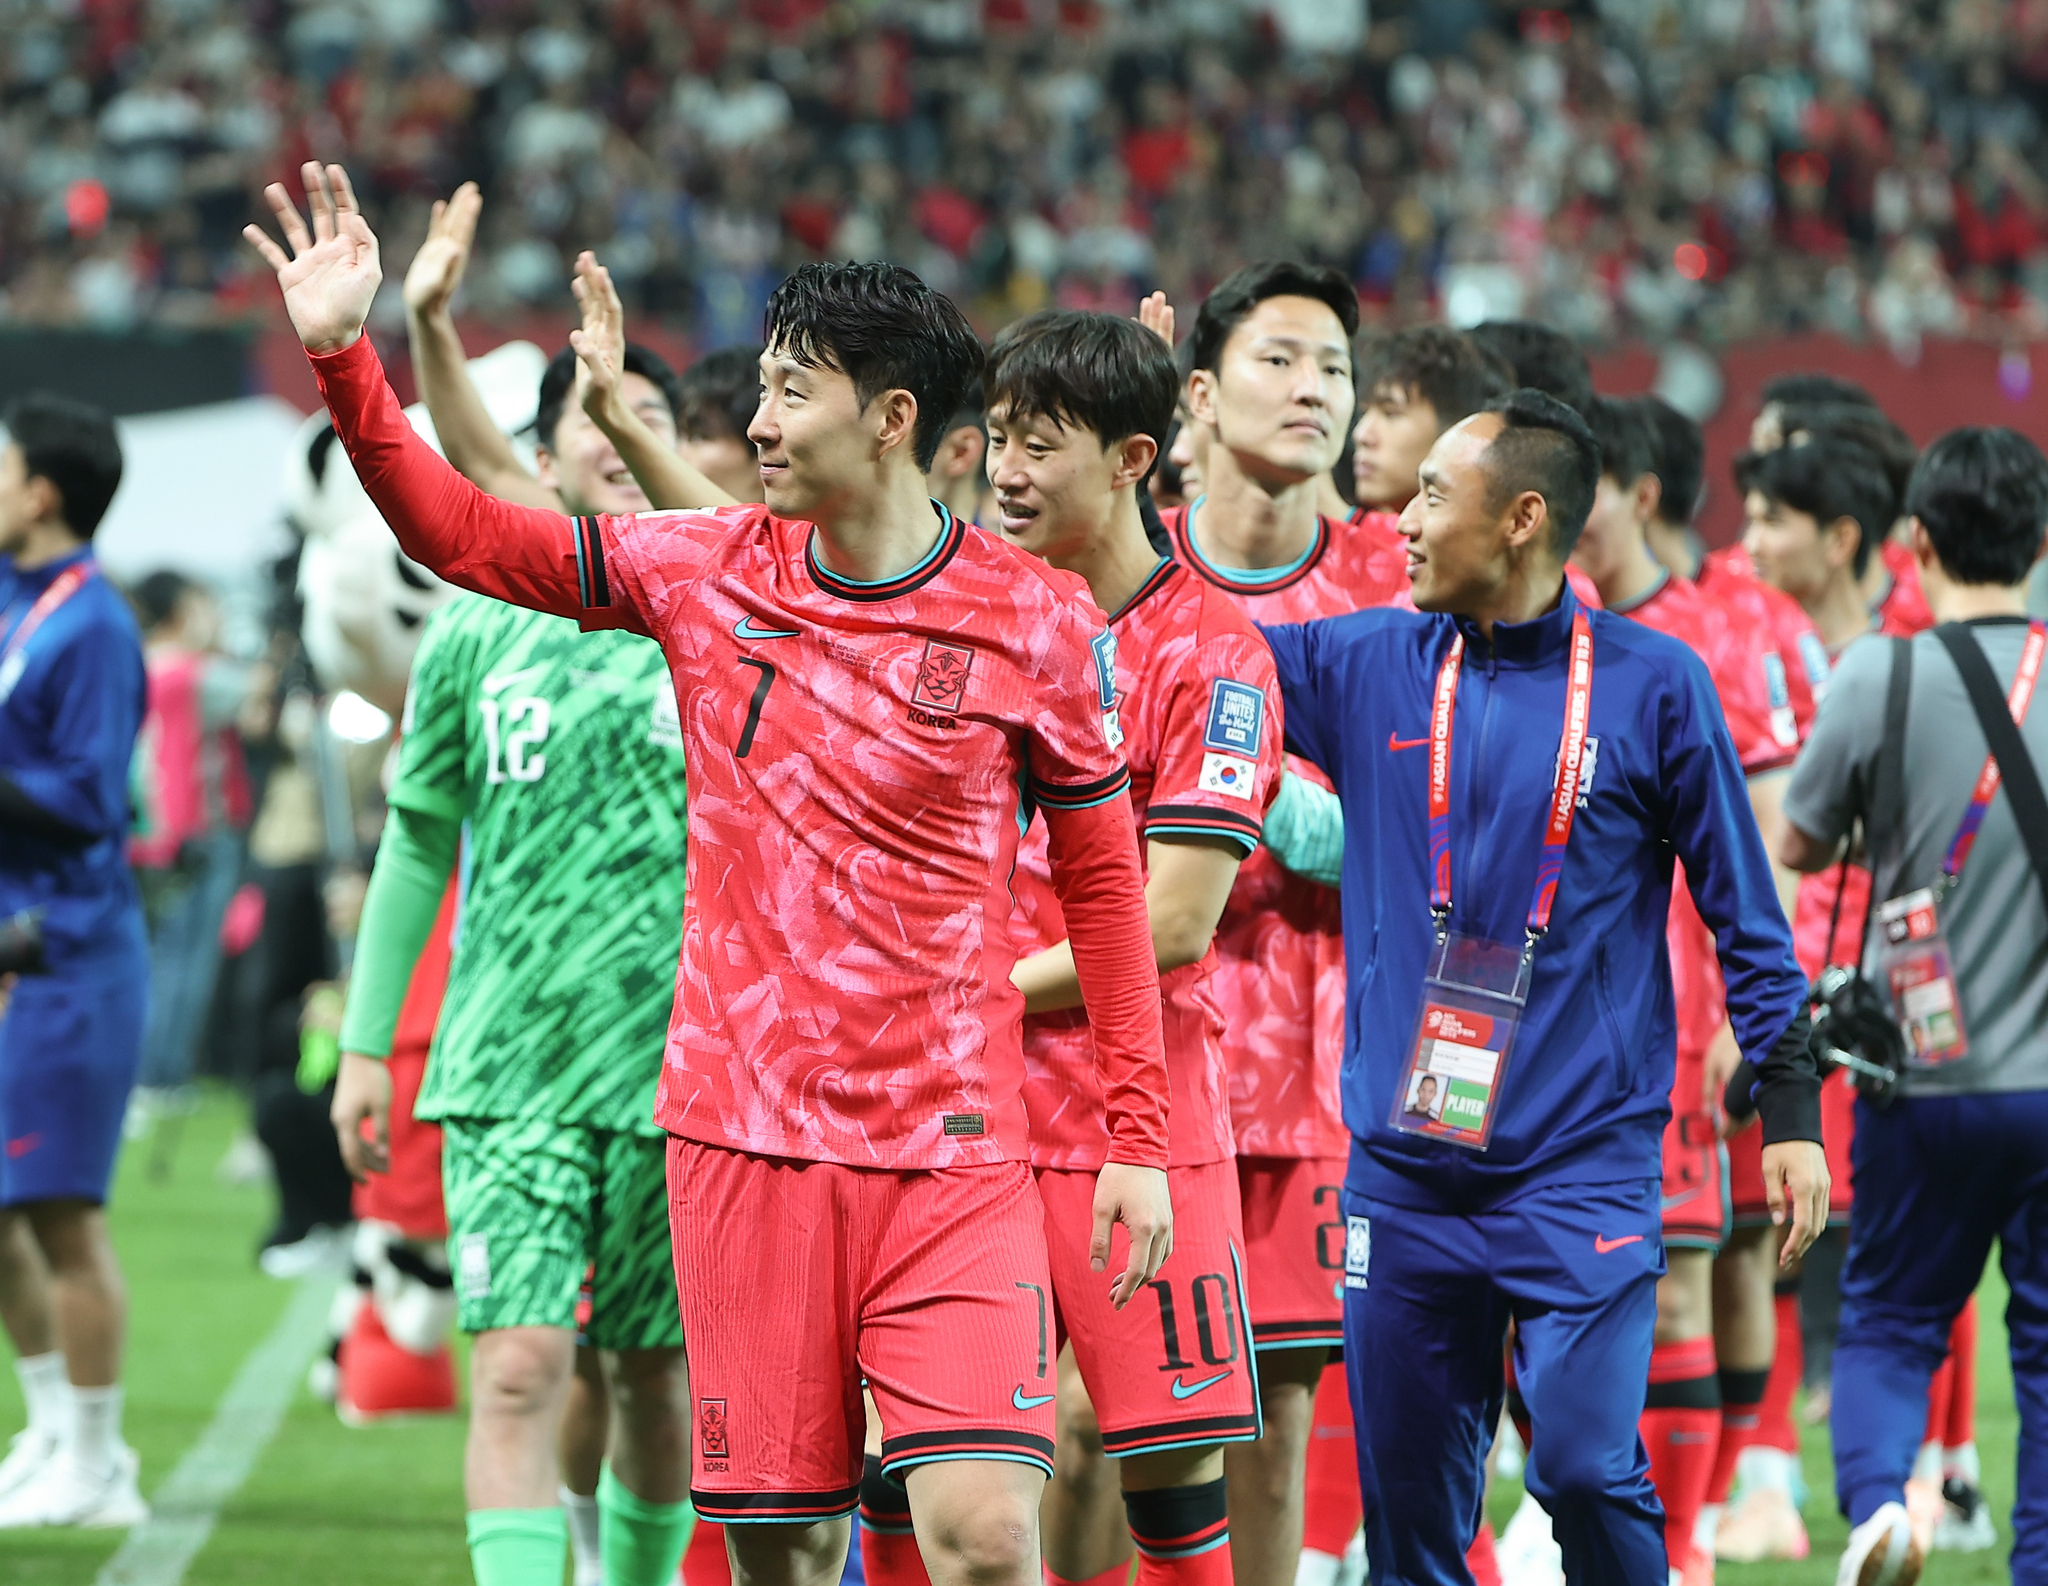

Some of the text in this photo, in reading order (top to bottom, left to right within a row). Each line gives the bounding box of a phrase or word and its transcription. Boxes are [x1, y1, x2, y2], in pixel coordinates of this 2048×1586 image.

[735, 655, 776, 758] 7
[907, 709, 956, 730] KOREA
[1222, 700, 1255, 721] UNITES
[1566, 690, 1586, 769] QUALIFIERS
[477, 697, 550, 784] 12
[1434, 741, 1446, 787] ASIAN
[1558, 770, 1577, 815] ASIAN
[1446, 1094, 1484, 1117] PLAYER
[1015, 1282, 1047, 1379] 7
[1147, 1273, 1238, 1371] 10
[703, 1462, 730, 1473] KOREA
